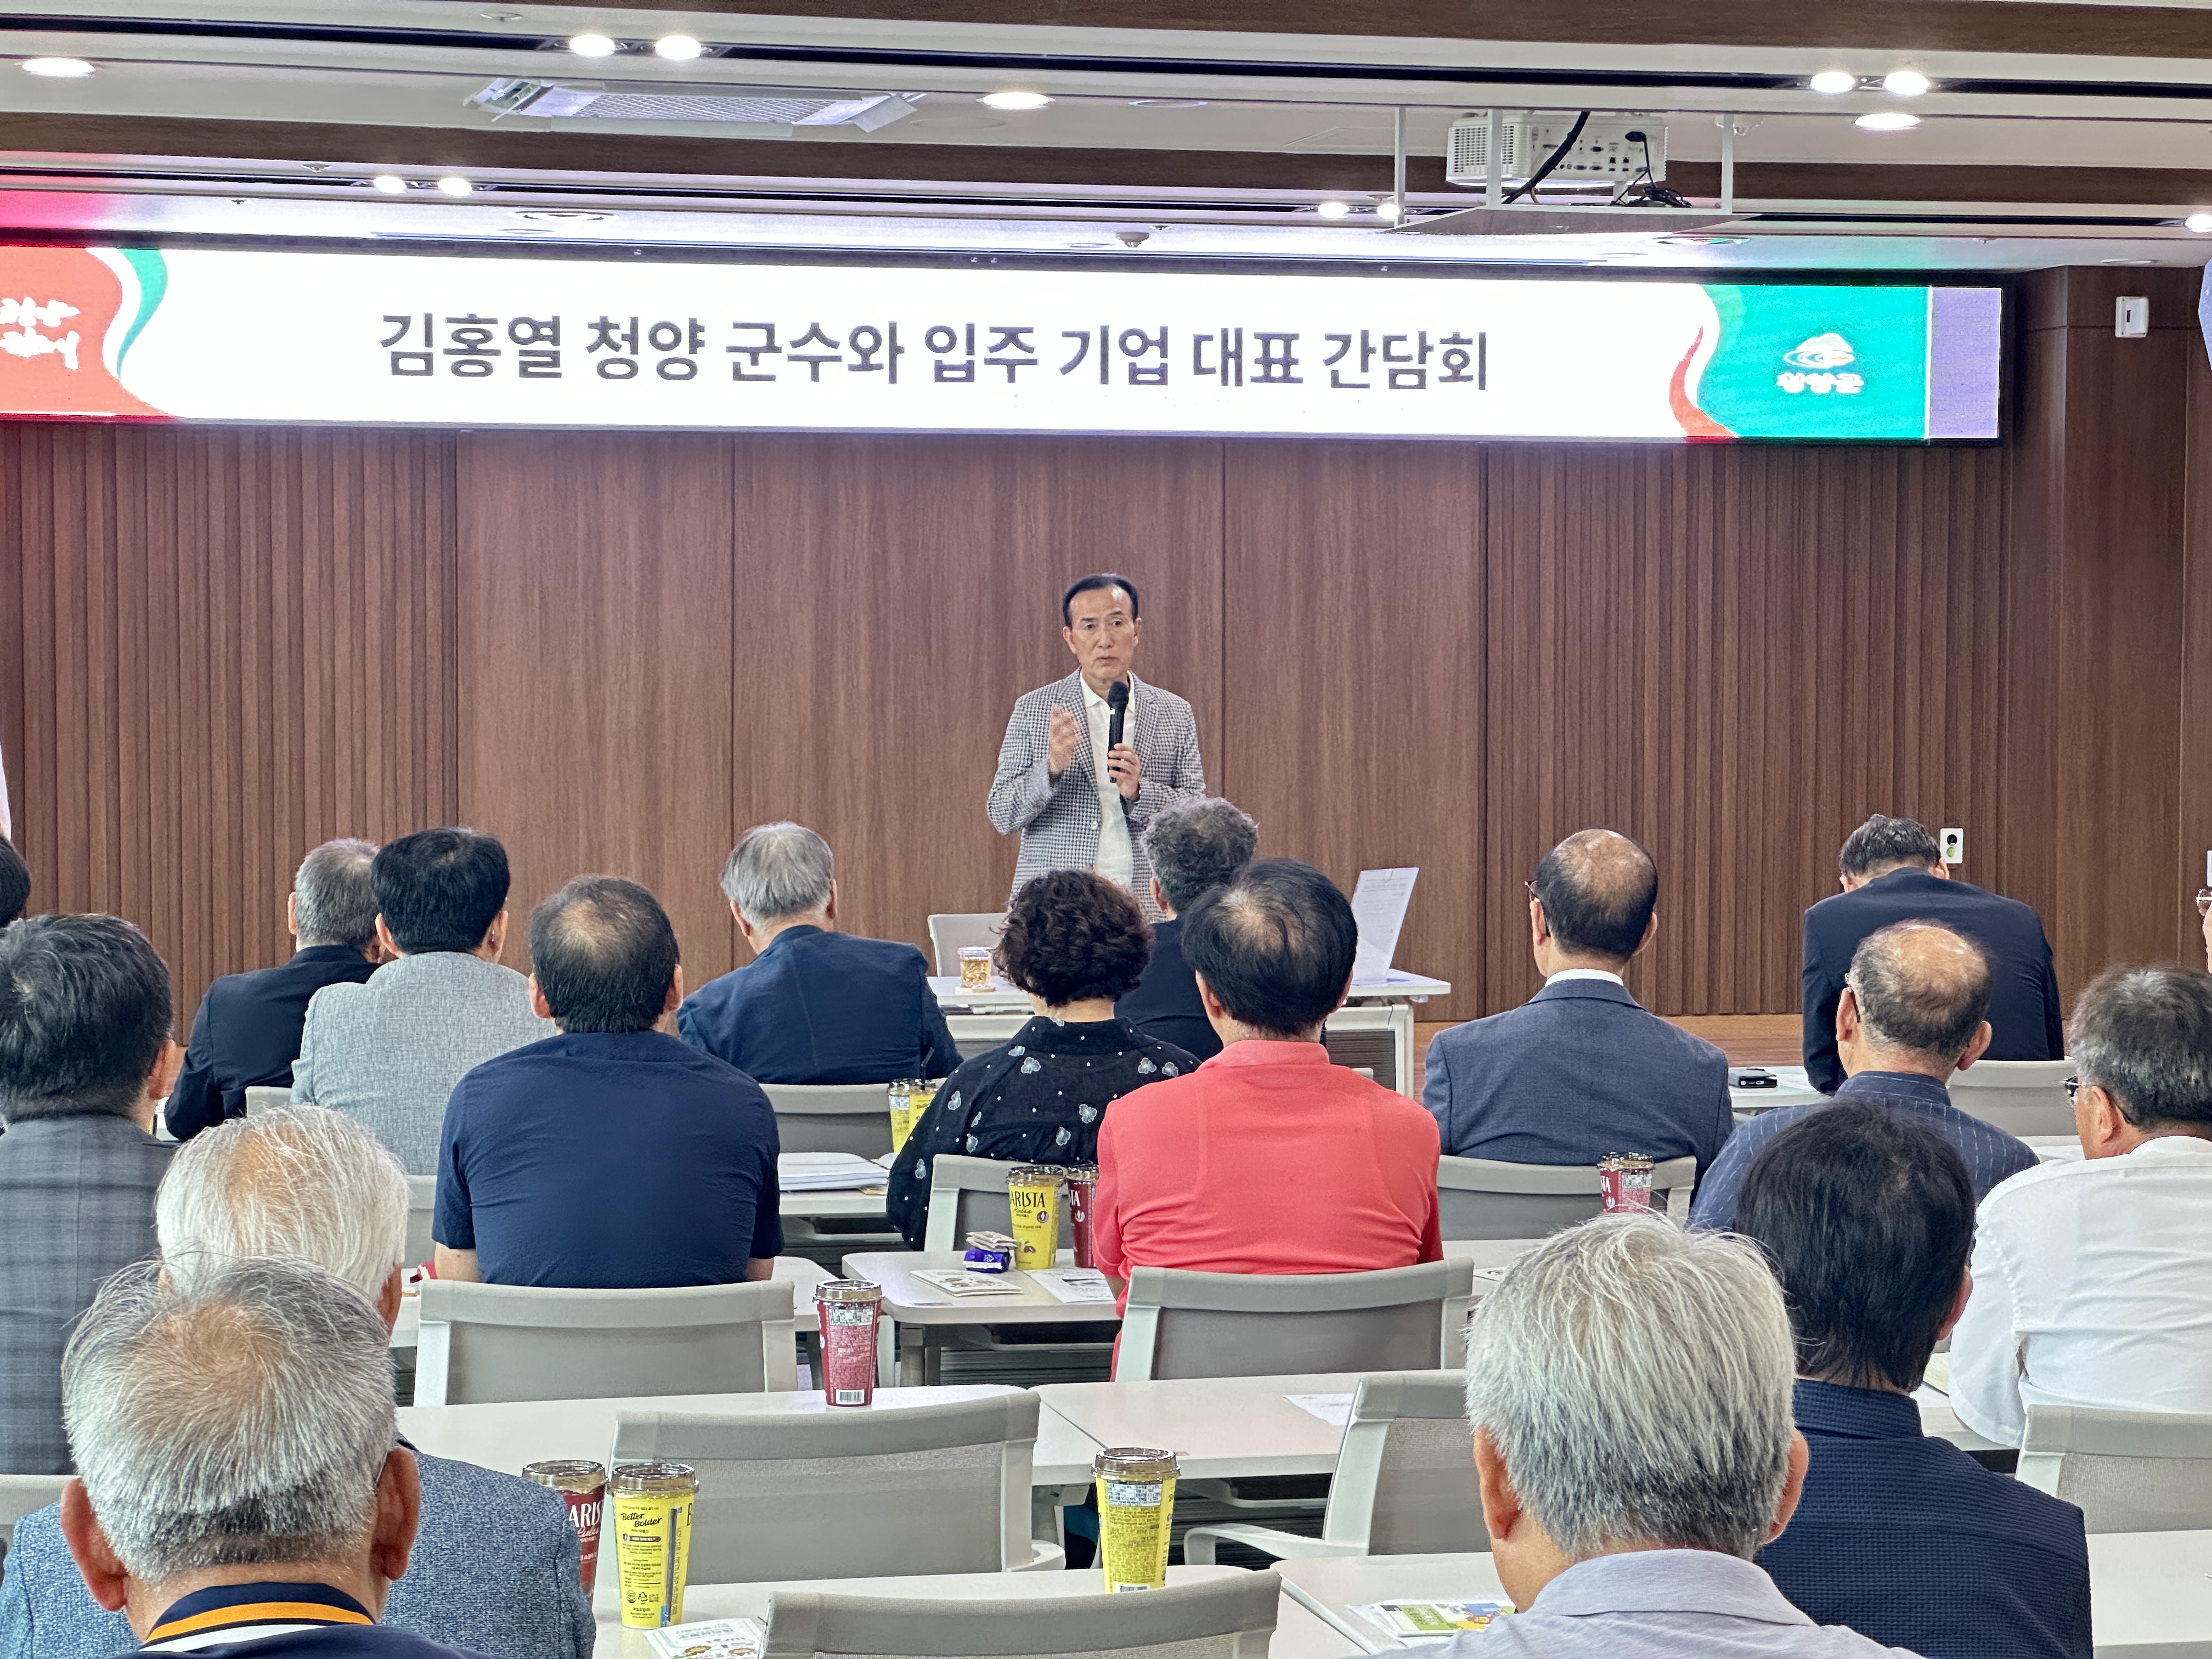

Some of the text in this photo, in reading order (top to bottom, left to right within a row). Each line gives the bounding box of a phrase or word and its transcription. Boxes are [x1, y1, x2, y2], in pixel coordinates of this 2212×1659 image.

[381, 312, 1487, 391] 김홍열 청양 군수와 입주 기업 대표 간담회
[634, 1517, 663, 1528] Bolder
